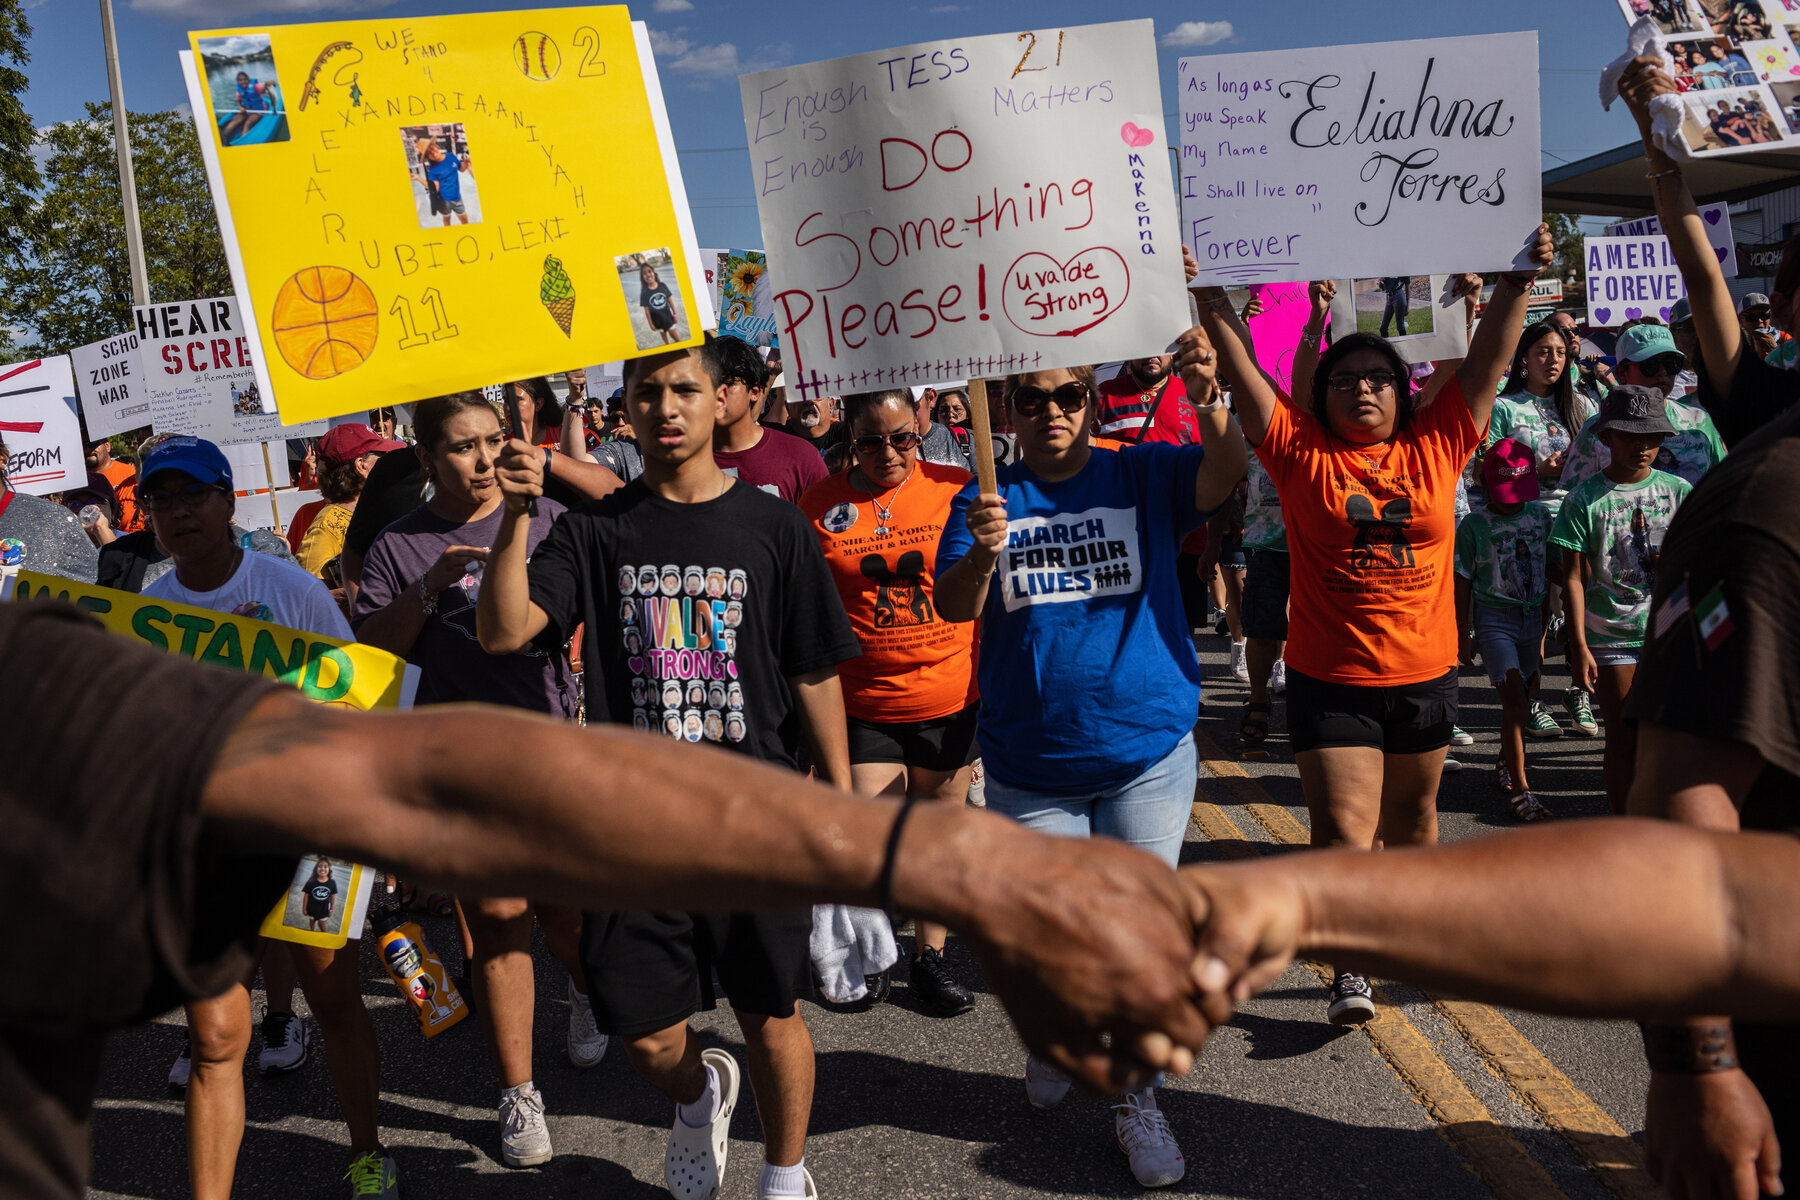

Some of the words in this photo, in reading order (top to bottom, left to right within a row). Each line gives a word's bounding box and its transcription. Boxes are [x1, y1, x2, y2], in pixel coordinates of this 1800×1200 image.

[374, 27, 415, 51] WE
[402, 41, 449, 65] STAND
[572, 25, 606, 79] 2
[1010, 29, 1066, 81] 21
[422, 64, 434, 85] 4
[876, 47, 970, 93] TESS
[1216, 71, 1249, 101] long
[1253, 77, 1273, 93] as
[754, 79, 868, 145] Enough
[992, 78, 1115, 117] Matters
[1278, 56, 1515, 149] Eliahna
[800, 120, 829, 142] is
[1185, 109, 1213, 133] you
[761, 144, 865, 198] Enough
[879, 128, 973, 193] DO
[1184, 175, 1198, 199] I
[1254, 179, 1287, 198] live
[1354, 147, 1506, 228] Torres
[321, 212, 496, 278] RUBIO,
[497, 214, 570, 254] LEXI
[794, 177, 1095, 293] Something
[1023, 285, 1110, 321] Strong
[1529, 286, 1553, 296] AUL
[1589, 274, 1688, 302] FOREVE
[136, 300, 232, 340] HEAR
[388, 286, 461, 351] 11
[773, 262, 991, 373] Please!
[100, 334, 139, 360] SCHO
[90, 360, 131, 386] ZONE
[193, 371, 254, 384] #Rememberth
[98, 383, 129, 406] WAR
[8, 446, 62, 475] EFORM
[832, 533, 893, 548] UNHEARD
[843, 543, 883, 557] MARCH
[887, 541, 895, 549] &
[899, 533, 935, 546] RALLY
[1008, 518, 1106, 549] MARCH
[1009, 547, 1066, 572] FOR
[1068, 540, 1129, 567] OUR
[1011, 569, 1093, 600] LIVES
[636, 596, 728, 652] UVALDE
[132, 604, 355, 702] STAND
[642, 649, 726, 681] STRONG
